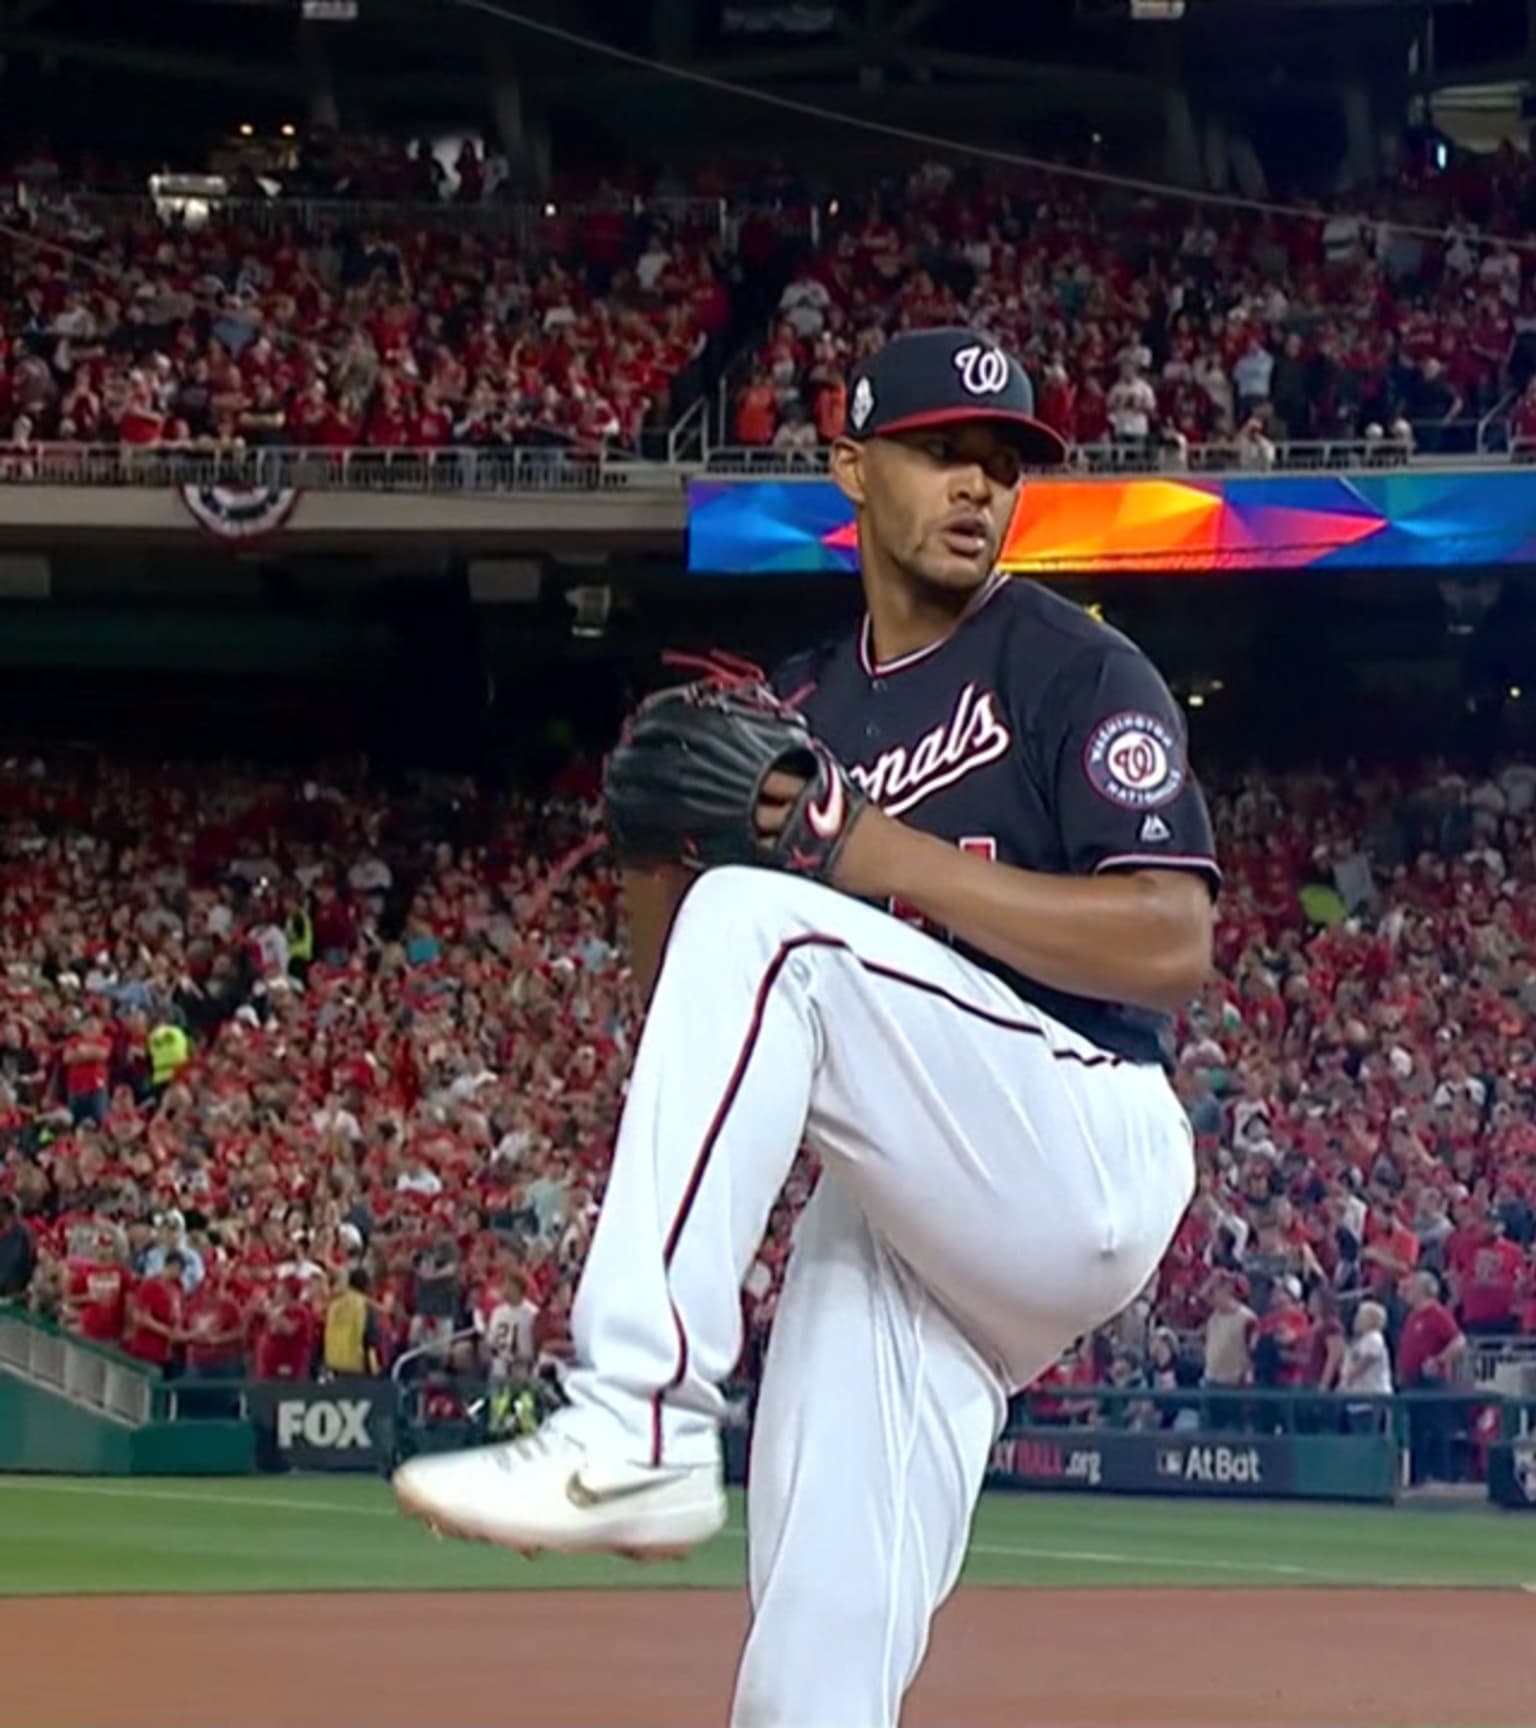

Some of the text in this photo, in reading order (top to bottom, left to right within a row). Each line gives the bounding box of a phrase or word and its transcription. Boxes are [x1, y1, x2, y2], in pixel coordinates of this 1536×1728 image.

[955, 346, 1009, 394] W
[850, 681, 1010, 818] nals
[276, 1400, 372, 1447] FOX
